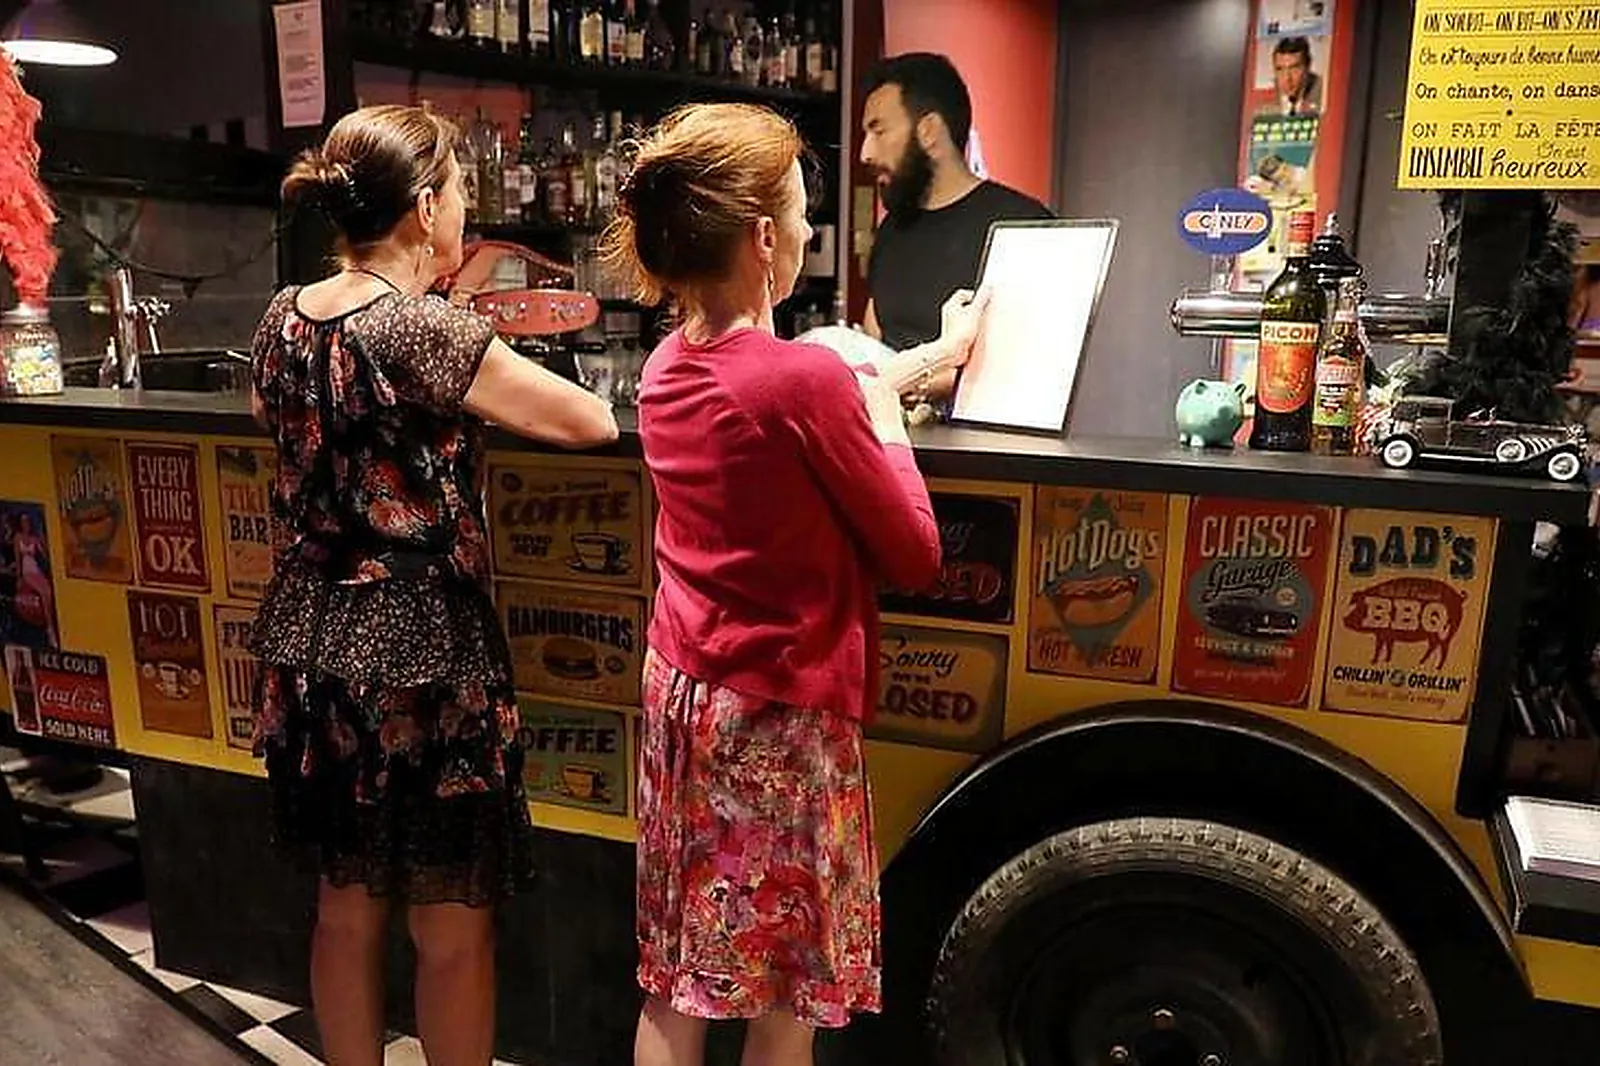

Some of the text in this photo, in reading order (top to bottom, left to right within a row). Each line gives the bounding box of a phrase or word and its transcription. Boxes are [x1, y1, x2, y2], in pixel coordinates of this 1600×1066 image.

[1415, 82, 1437, 99] On
[1522, 84, 1544, 98] on
[1412, 123, 1437, 138] ON
[1451, 123, 1502, 138] FAIT
[1515, 123, 1540, 138] LA
[1490, 148, 1588, 178] heureux
[1263, 323, 1317, 342] PICON
[137, 455, 190, 488] EVERY
[141, 488, 193, 523] THING
[229, 512, 269, 545] BAR
[1200, 513, 1317, 560] CLASSIC
[149, 533, 201, 576] OK
[1349, 525, 1478, 581] DAD'S
[1208, 560, 1300, 598] Garage
[506, 605, 635, 653] HAMBURGERS
[1361, 596, 1450, 639] BBQ
[1333, 665, 1390, 685] CHILLIN'
[514, 726, 618, 756] OFFEE
